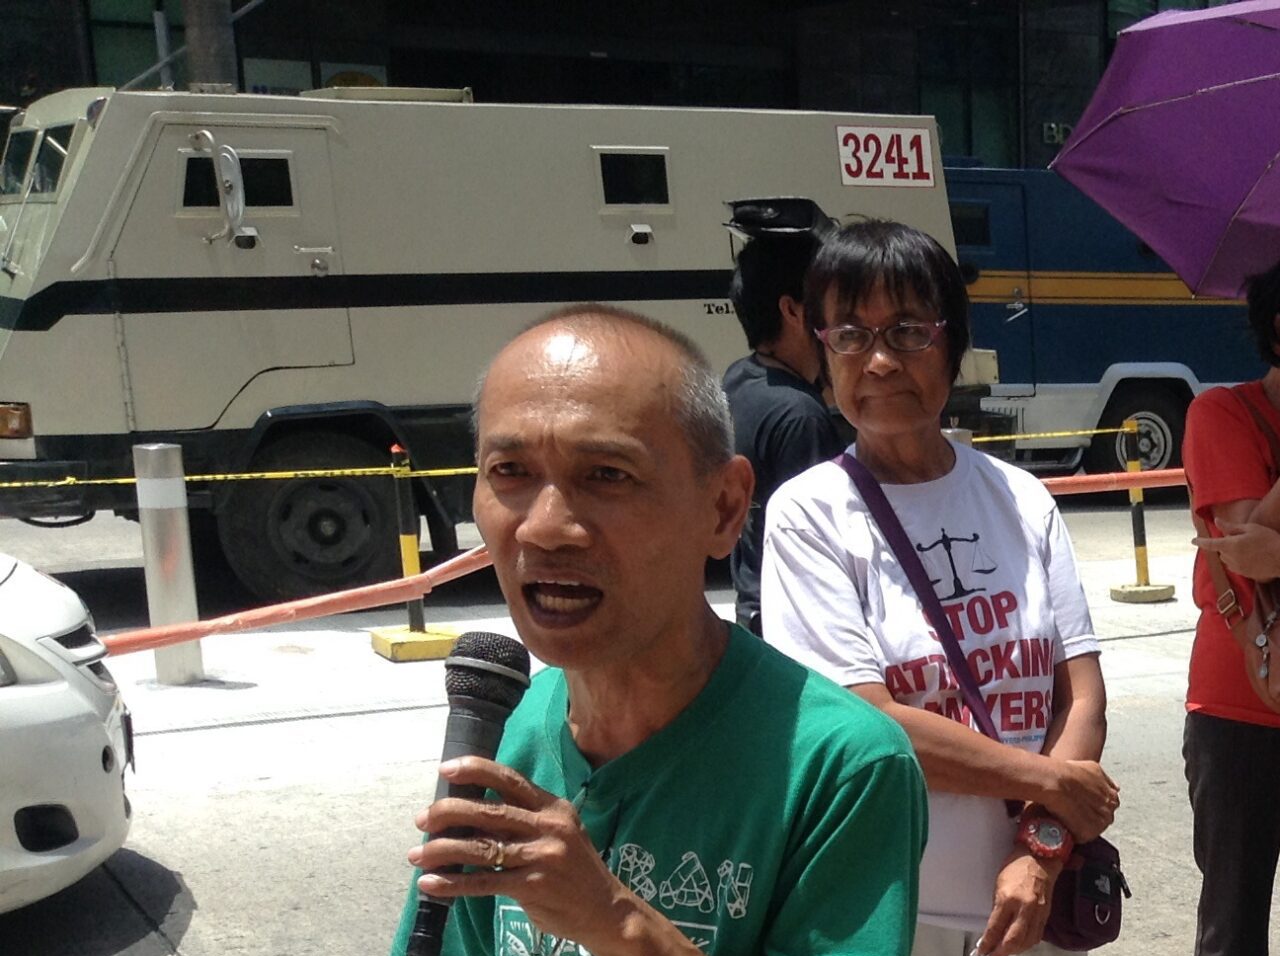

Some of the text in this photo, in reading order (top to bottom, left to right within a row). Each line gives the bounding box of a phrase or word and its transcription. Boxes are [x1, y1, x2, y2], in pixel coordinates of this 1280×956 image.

[842, 132, 931, 181] 3241
[703, 302, 735, 315] Tel.
[922, 590, 1018, 641] TOP
